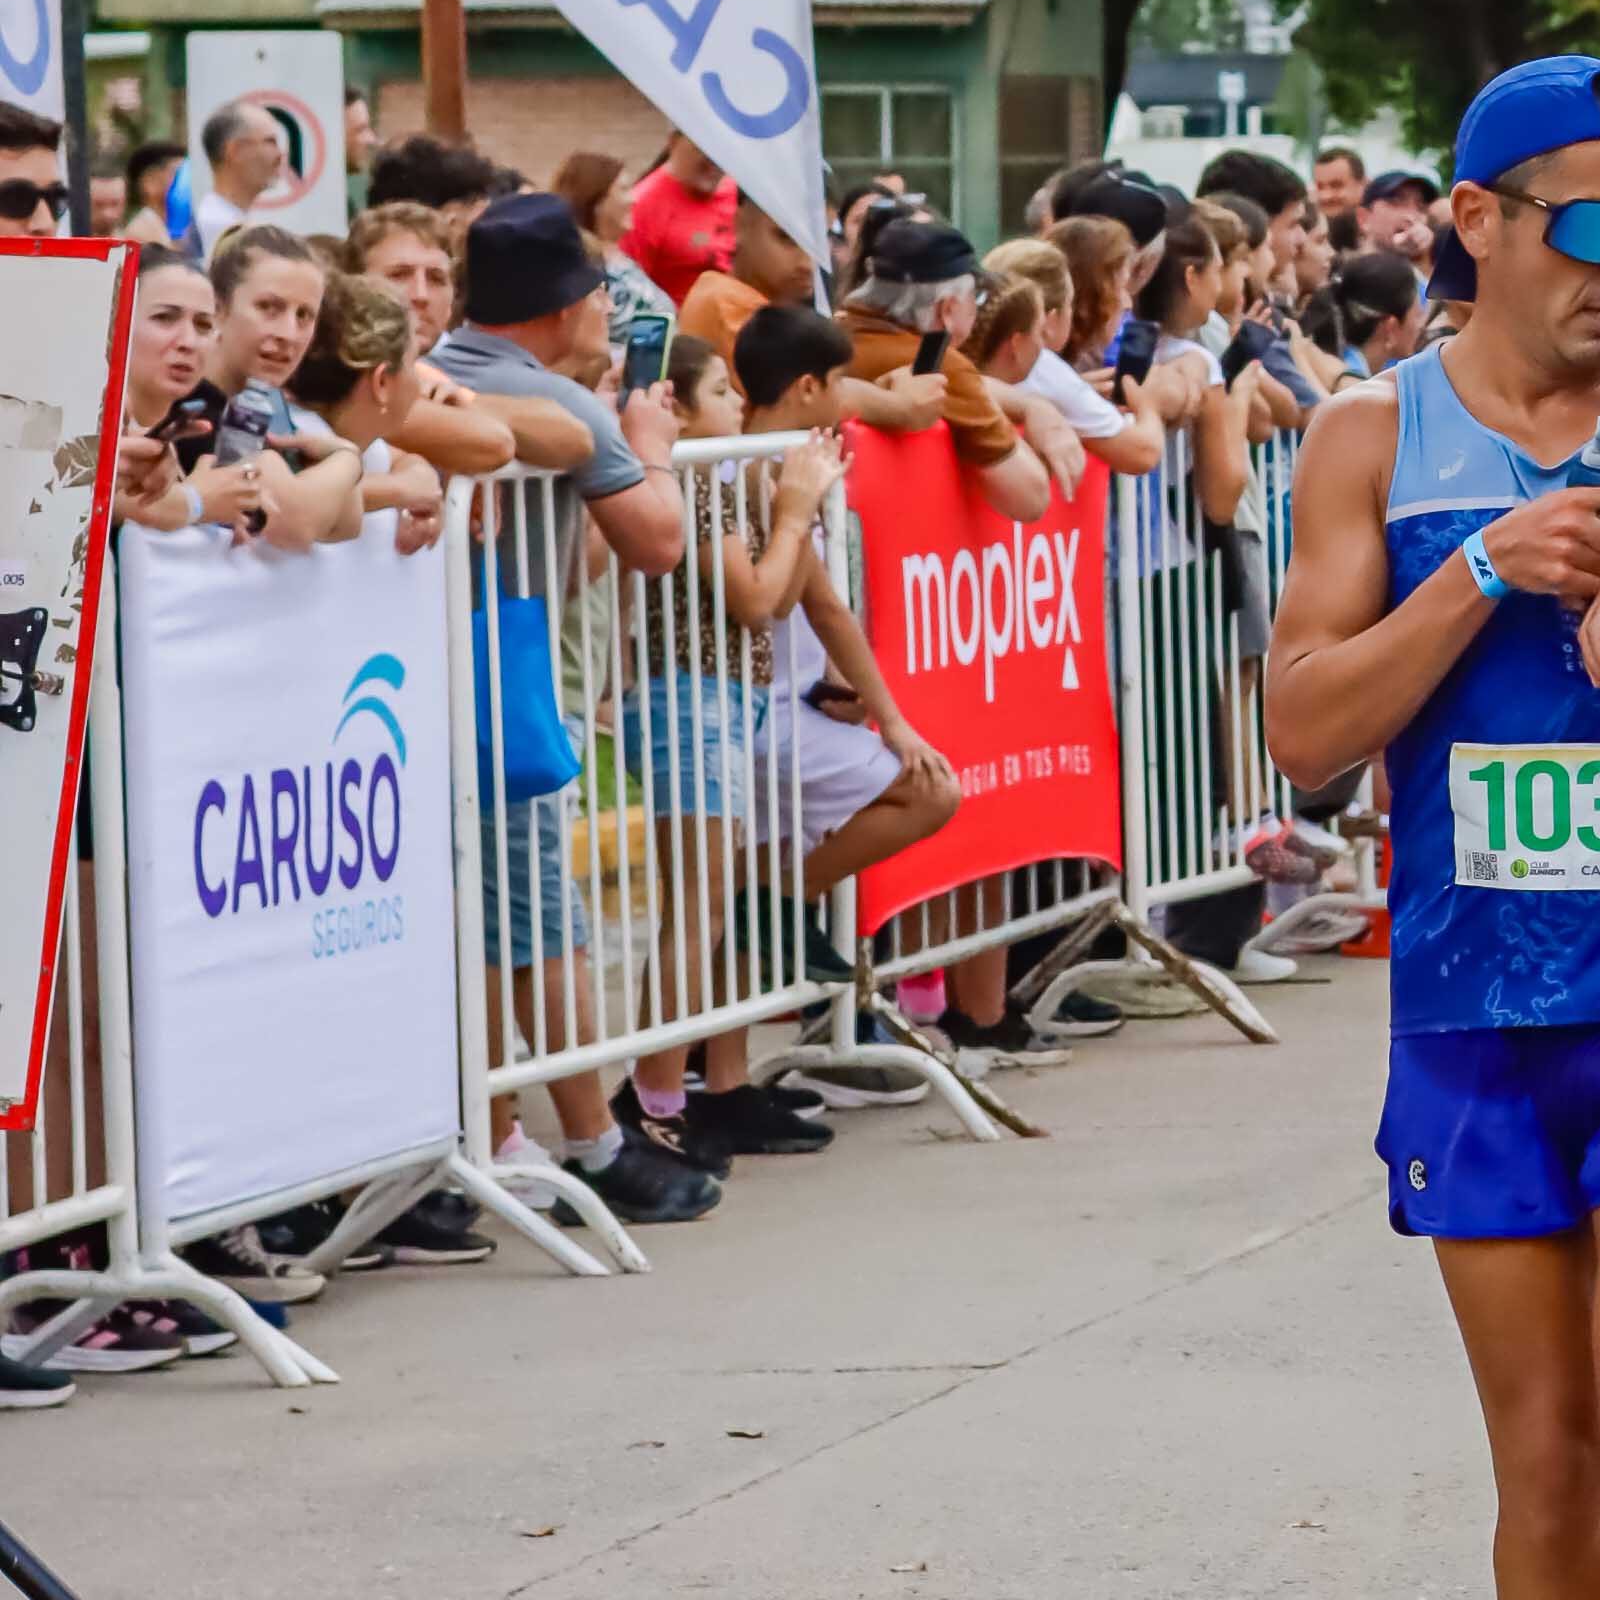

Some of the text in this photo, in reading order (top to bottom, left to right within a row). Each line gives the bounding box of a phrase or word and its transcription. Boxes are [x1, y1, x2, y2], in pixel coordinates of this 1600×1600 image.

[902, 520, 1081, 703] moplex
[194, 752, 400, 918] CARUSO
[312, 895, 402, 959] SEGUROS
